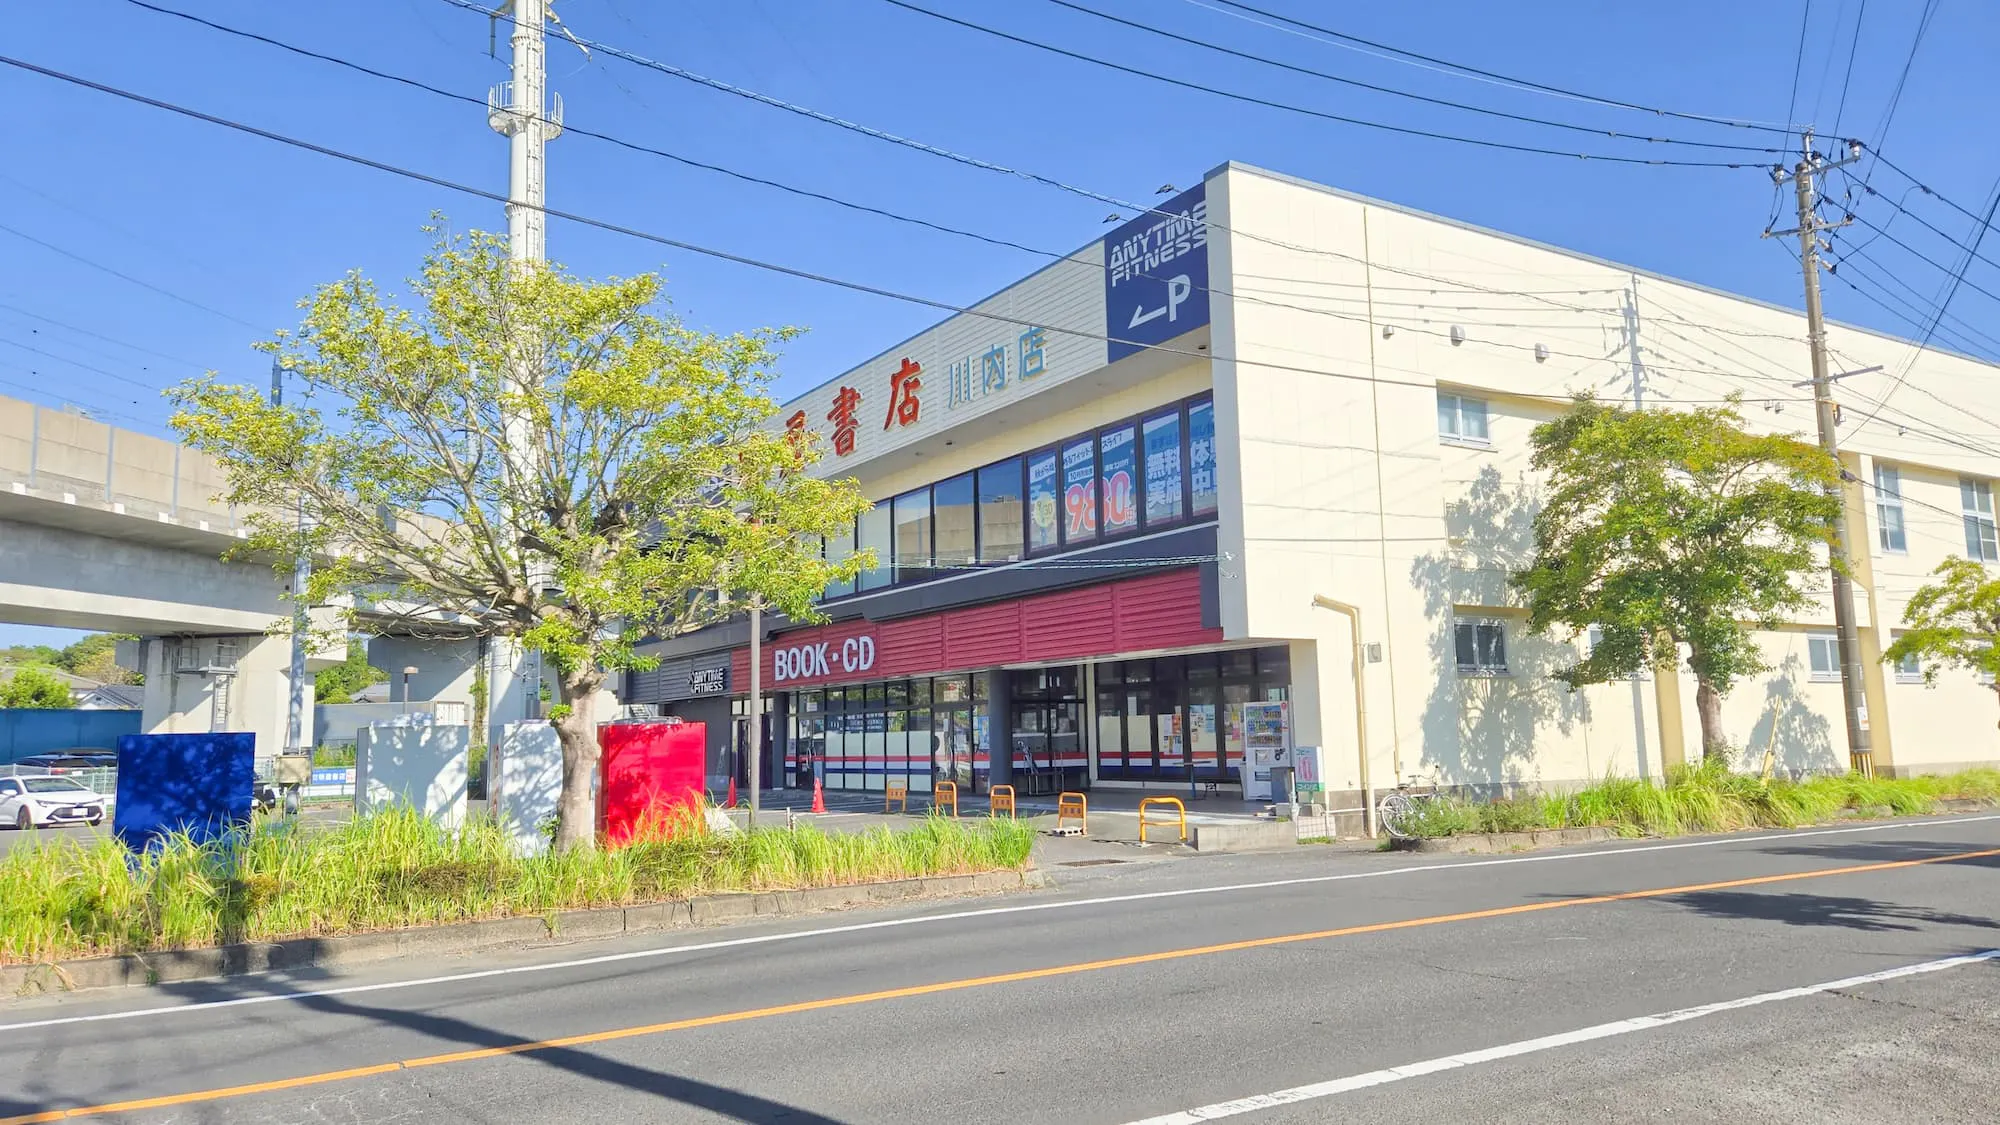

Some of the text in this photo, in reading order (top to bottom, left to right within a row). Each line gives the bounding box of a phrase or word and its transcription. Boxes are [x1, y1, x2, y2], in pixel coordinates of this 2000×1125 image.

[1110, 201, 1206, 269] ANYTIME
[1111, 226, 1206, 288] FITNESS
[1168, 273, 1191, 322] P
[948, 326, 1047, 409] 川内店
[693, 668, 724, 684] ANYTIME
[694, 682, 724, 693] FITNESS
